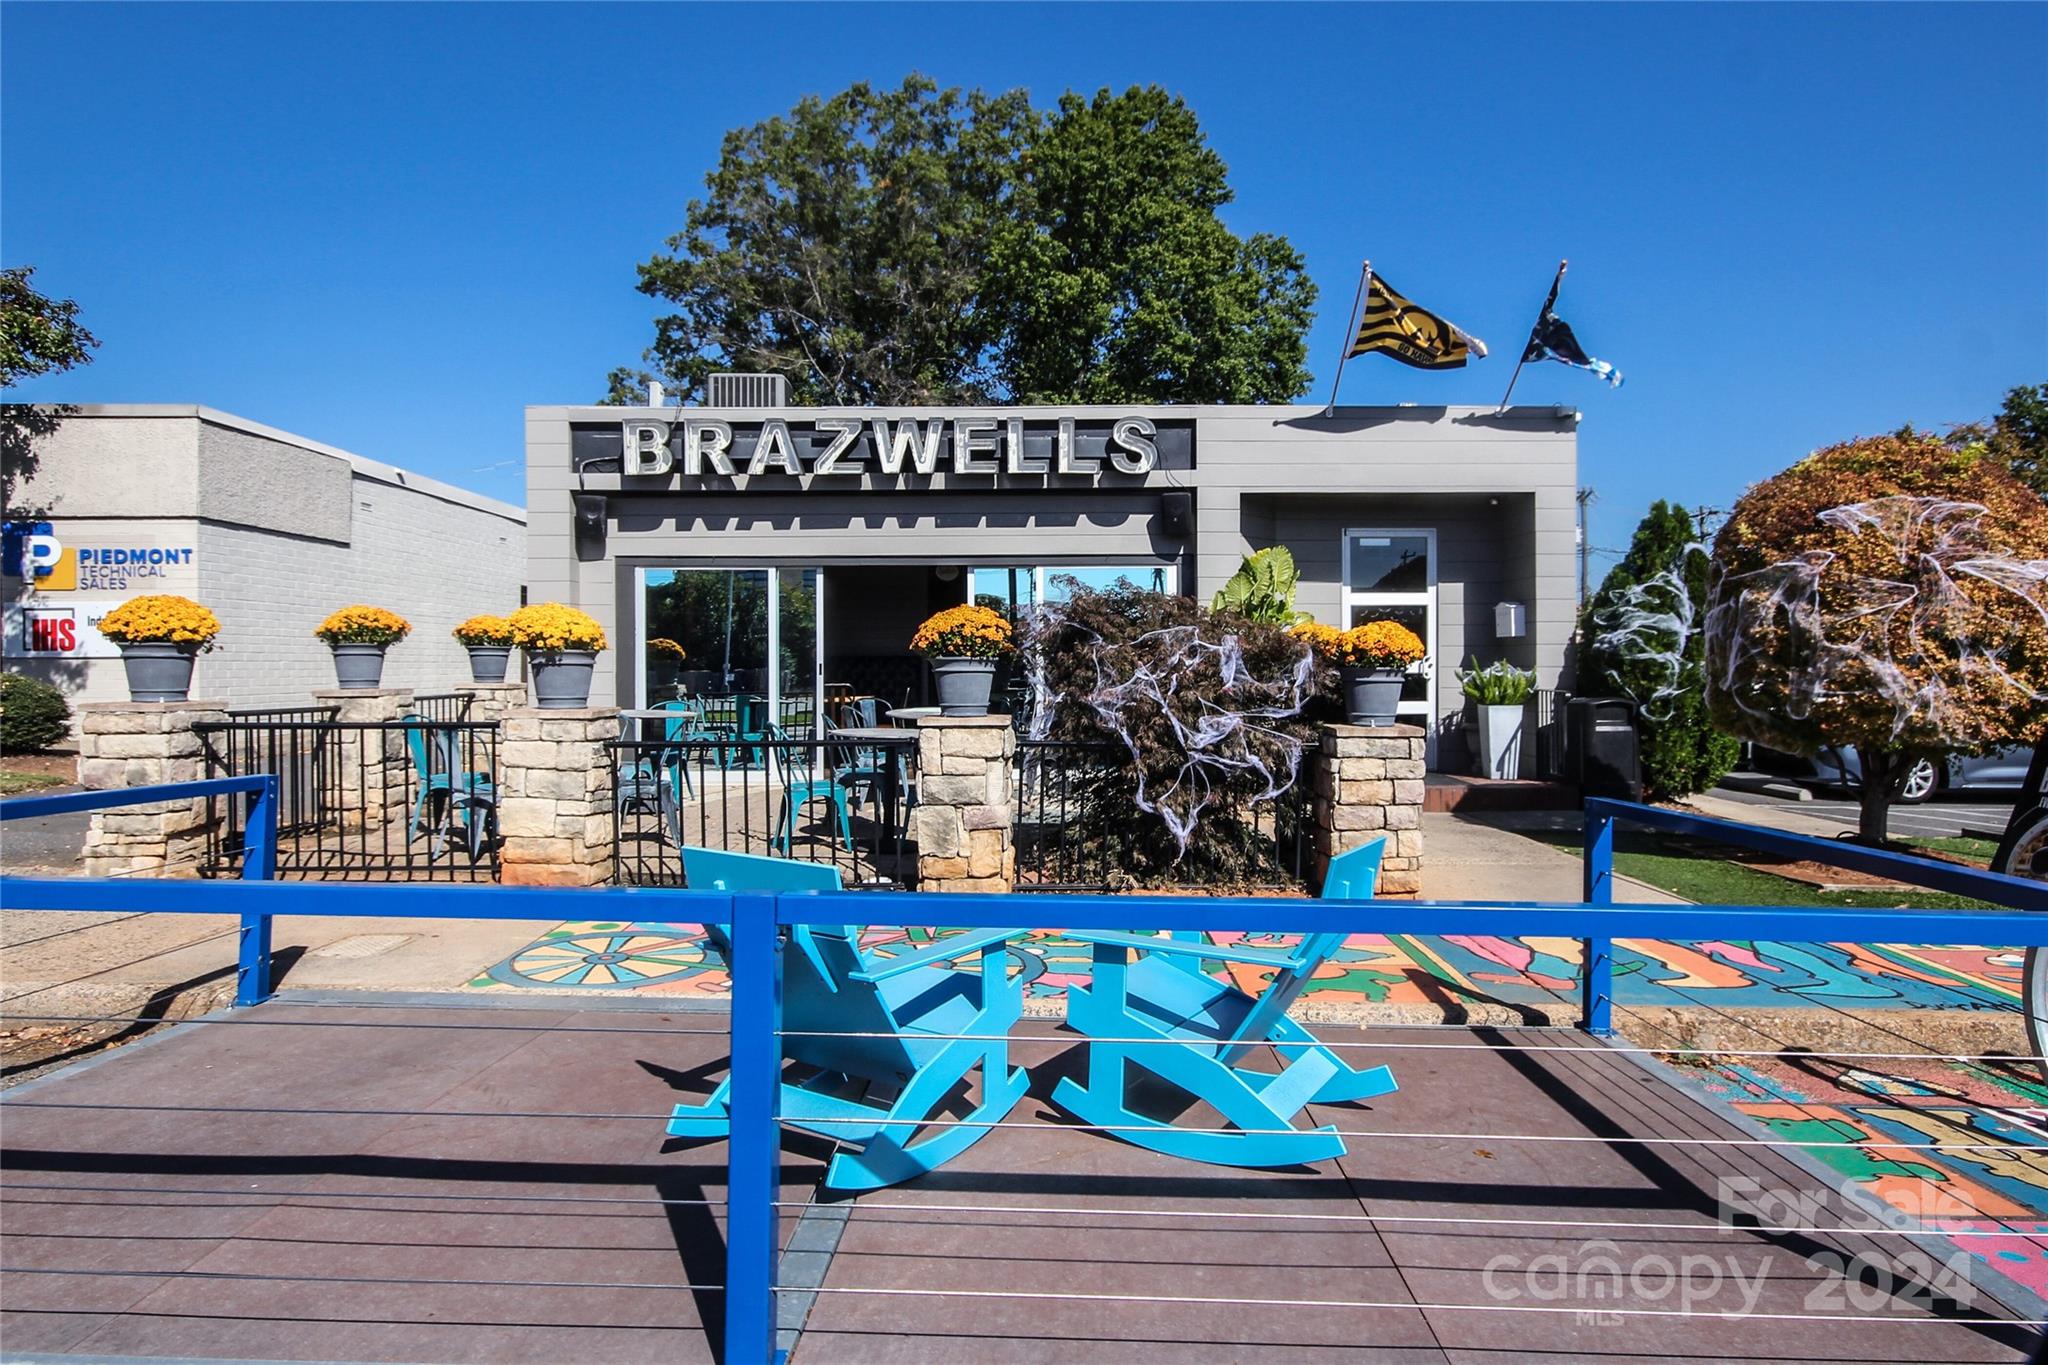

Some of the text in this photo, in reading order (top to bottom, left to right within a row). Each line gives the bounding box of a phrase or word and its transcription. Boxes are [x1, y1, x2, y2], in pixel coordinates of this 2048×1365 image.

[622, 416, 1158, 475] BRAZWELLS
[79, 548, 193, 565] PIEDMONT
[80, 565, 167, 578] TECHNICAL
[80, 578, 127, 590] SALES
[33, 618, 76, 652] IHS
